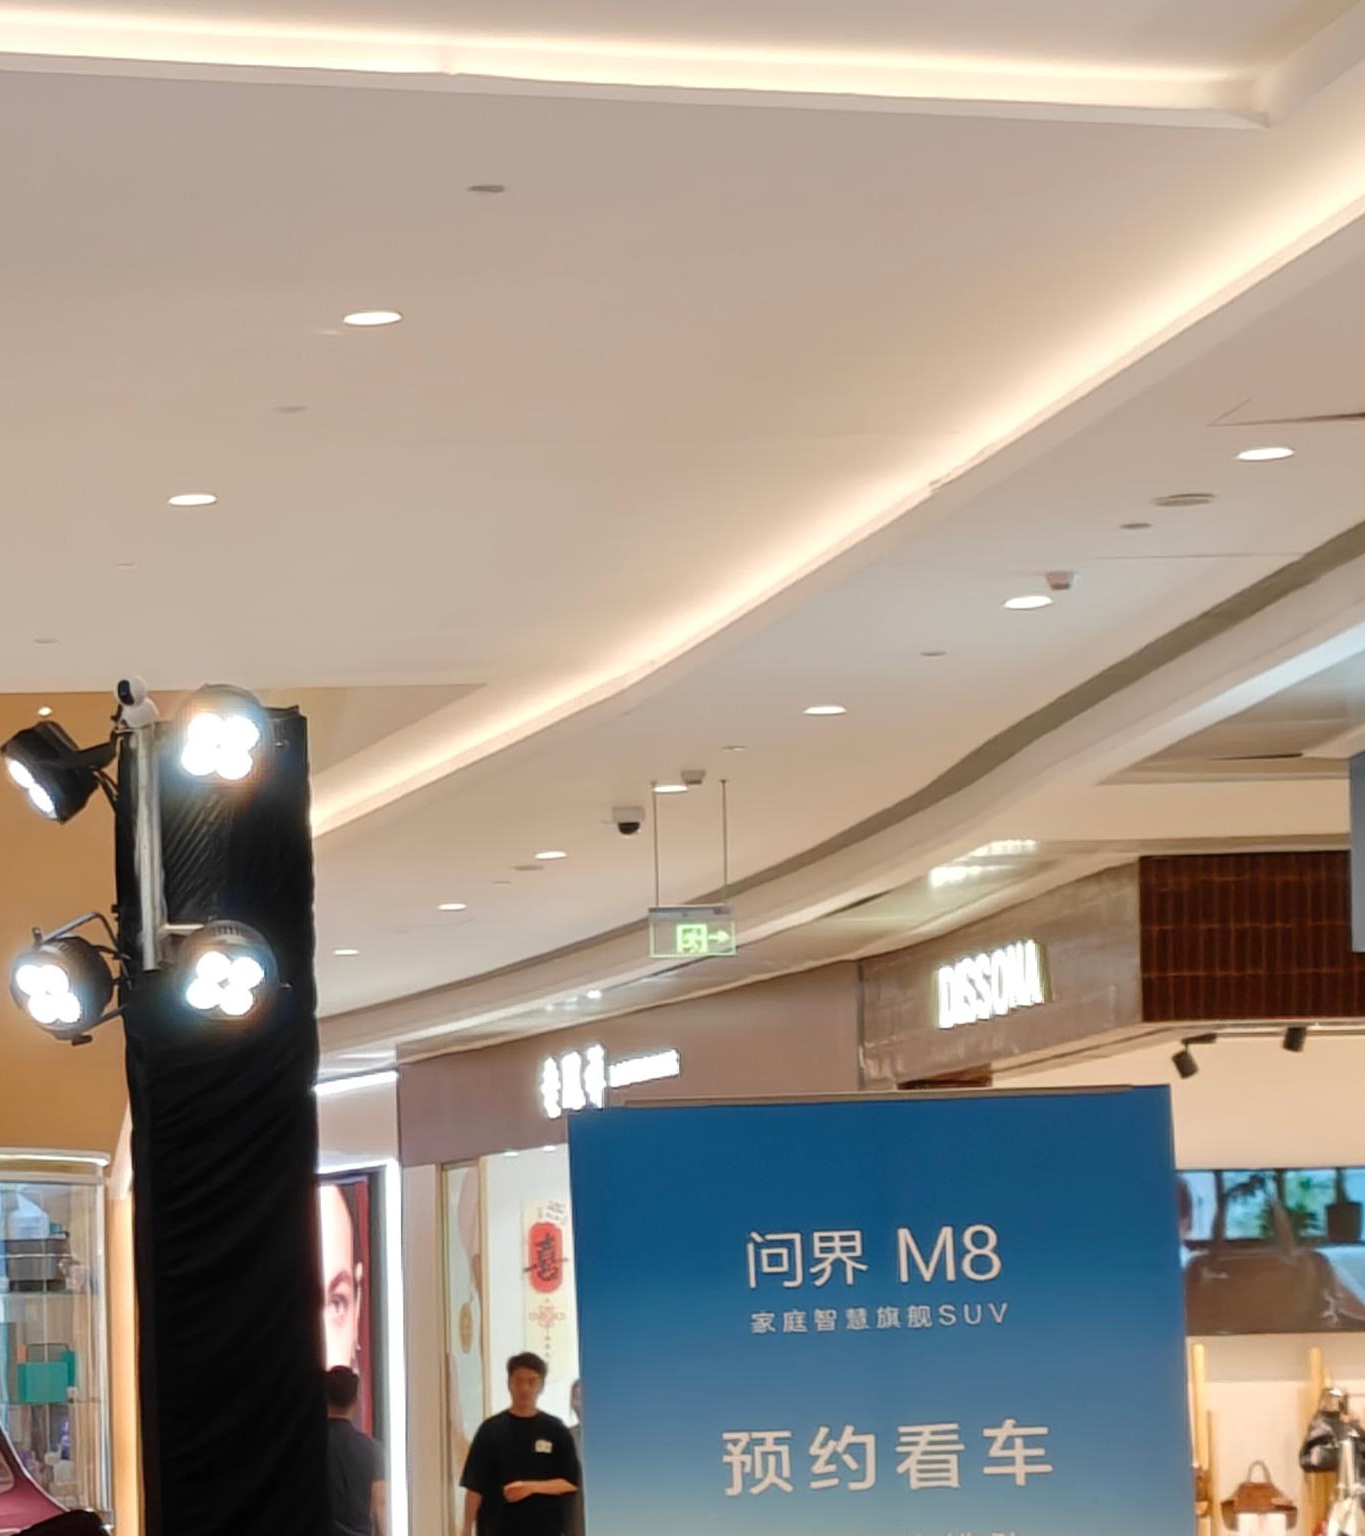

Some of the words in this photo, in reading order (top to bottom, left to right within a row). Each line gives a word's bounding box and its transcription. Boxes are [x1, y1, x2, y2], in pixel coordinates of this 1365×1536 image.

[746, 1230, 869, 1289] 问界
[896, 1224, 1002, 1283] M8
[750, 1302, 1008, 1334] 家庭智慧旗舰SUV
[722, 1418, 1053, 1496] 预约看车
